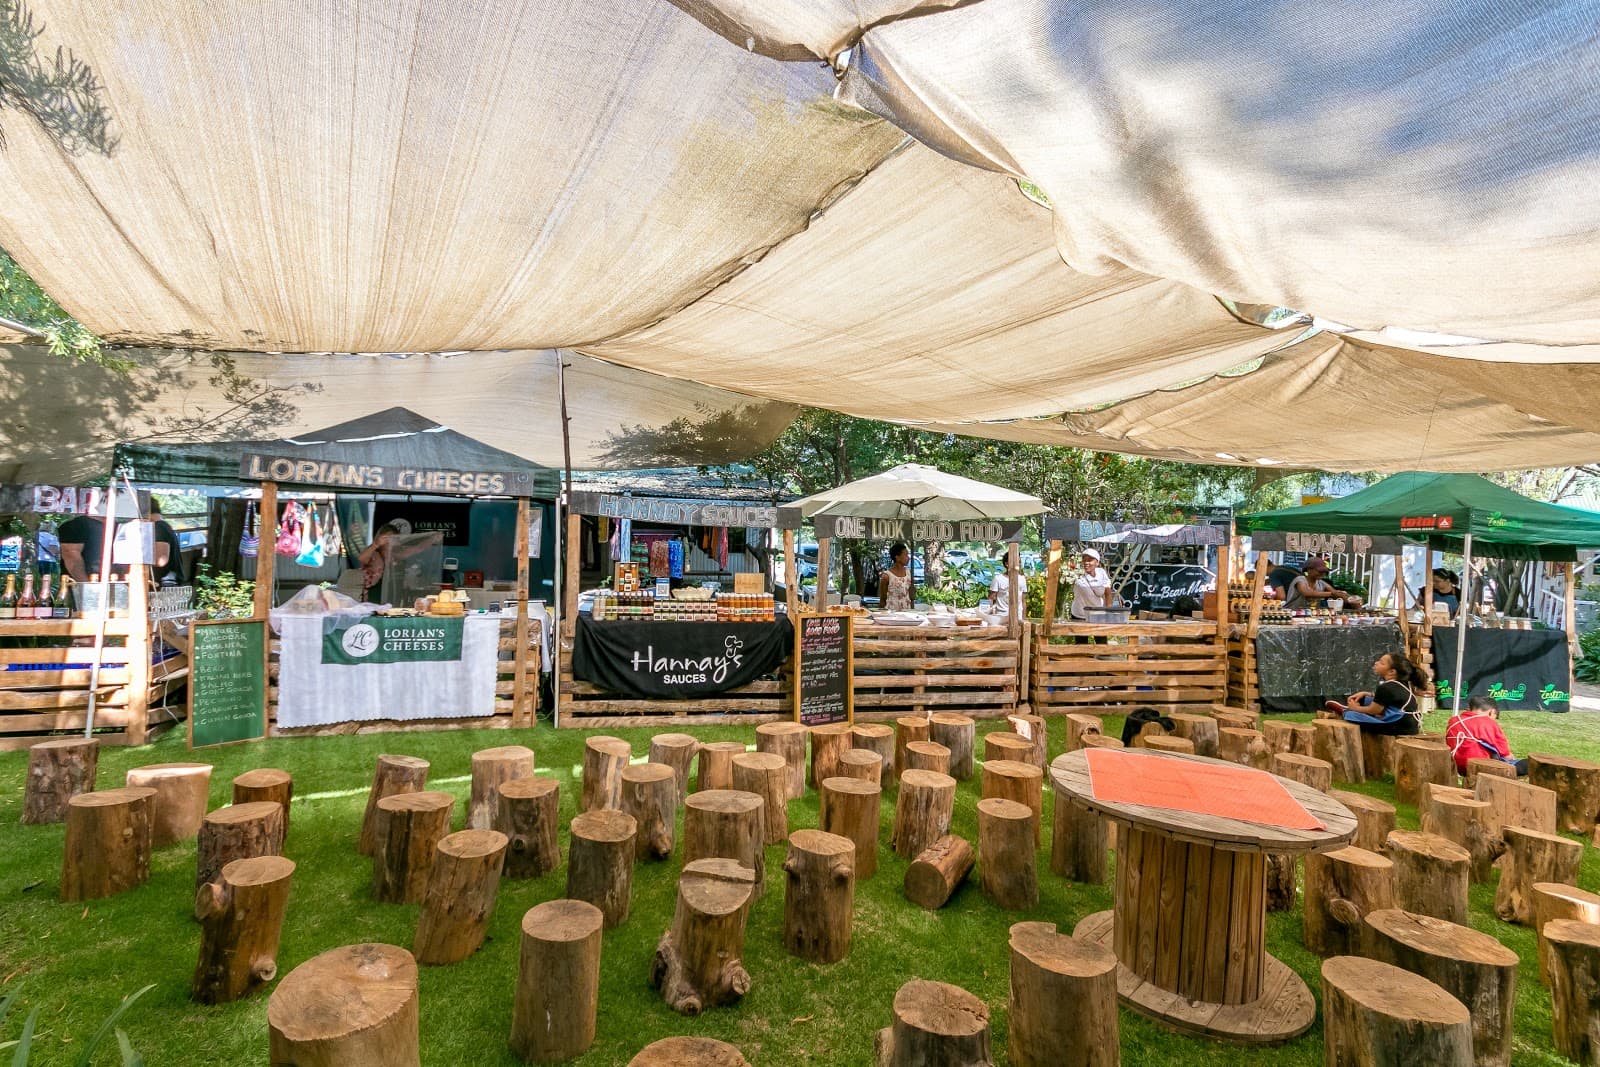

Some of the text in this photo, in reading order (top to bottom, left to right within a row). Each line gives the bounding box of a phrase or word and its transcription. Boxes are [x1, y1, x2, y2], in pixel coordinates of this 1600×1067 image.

[250, 454, 506, 494] LORIAN'S CHEESES
[33, 485, 101, 515] BAR
[414, 521, 457, 529] LORIAN'S
[834, 516, 1003, 543] ONE LOOK GOOD FOOD
[1160, 585, 1187, 599] Bean
[383, 628, 446, 639] LORIAN'S
[383, 641, 445, 652] CHEESES
[663, 673, 707, 684] SAUCES
